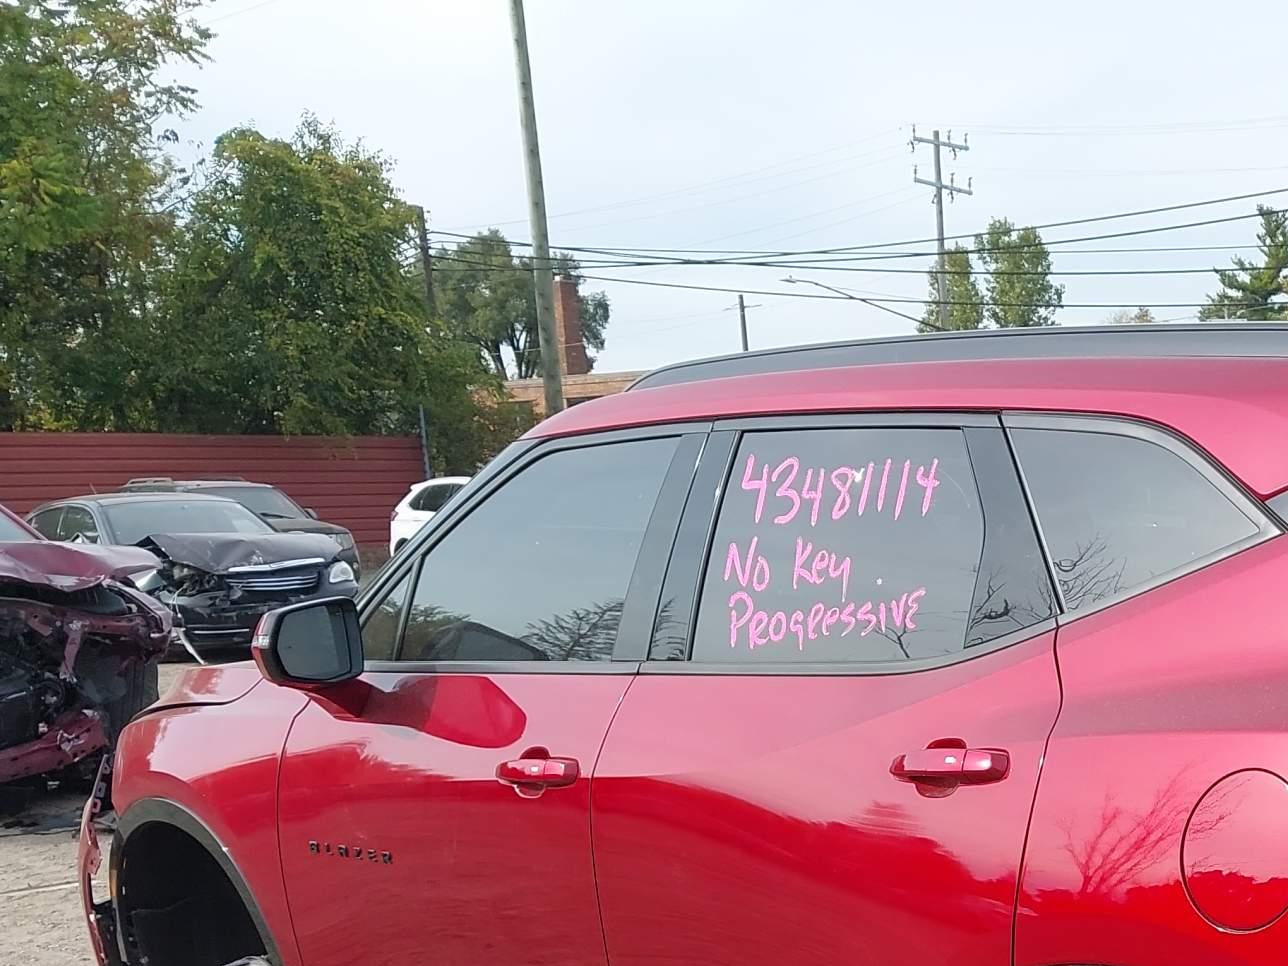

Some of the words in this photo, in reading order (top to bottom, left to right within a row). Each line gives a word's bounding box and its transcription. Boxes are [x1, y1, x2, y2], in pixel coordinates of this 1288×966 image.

[741, 454, 941, 527] 43481114
[792, 535, 851, 602] Key
[308, 840, 393, 865] BLAZER
